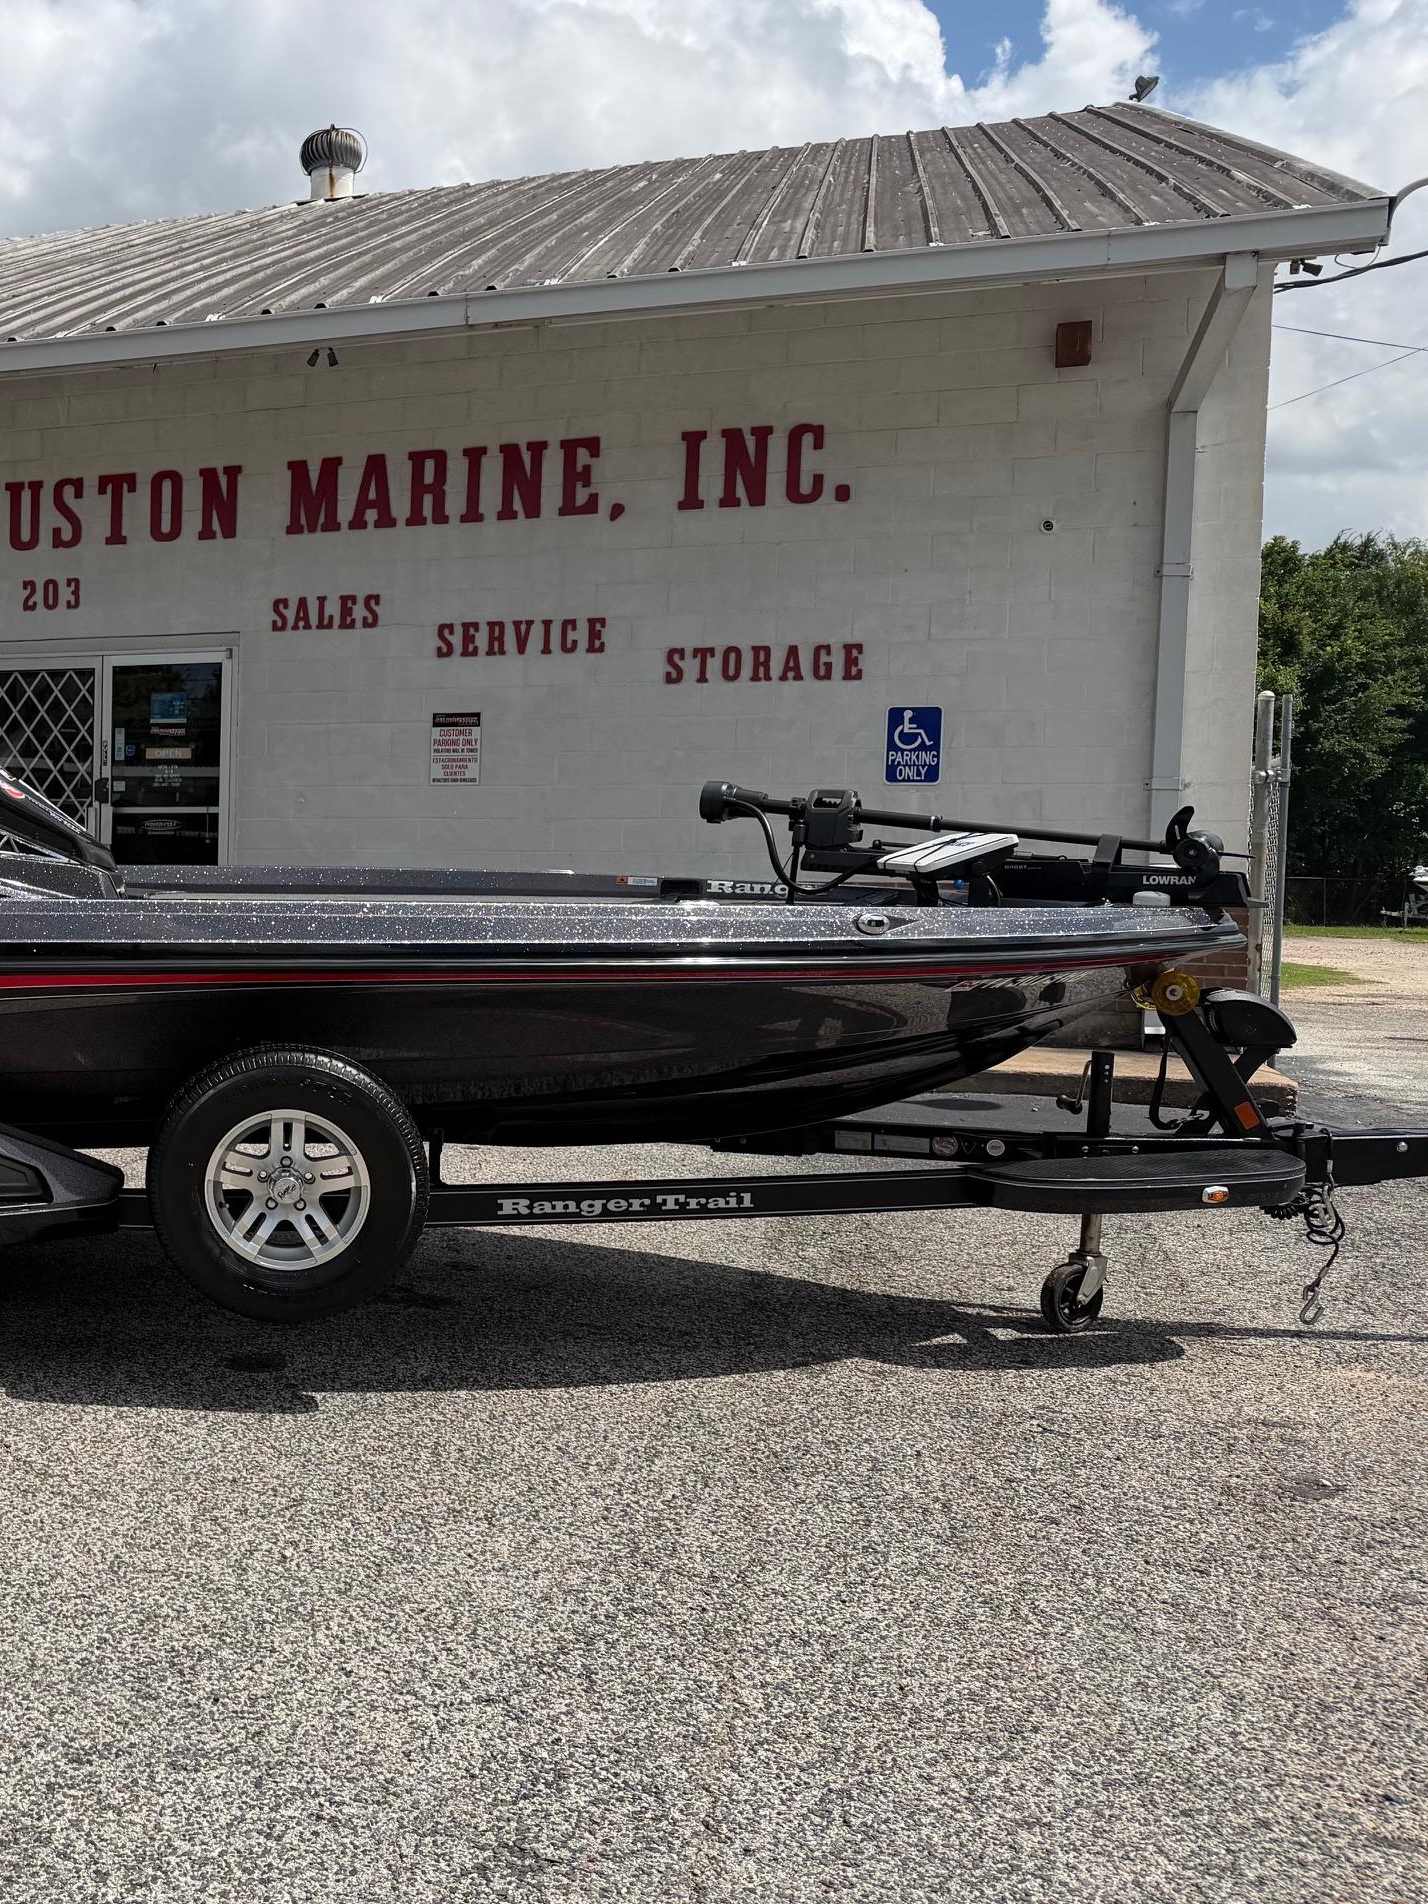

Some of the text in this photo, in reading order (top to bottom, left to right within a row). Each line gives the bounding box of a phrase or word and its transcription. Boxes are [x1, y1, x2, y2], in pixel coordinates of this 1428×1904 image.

[286, 436, 626, 535] MARINE,
[677, 423, 851, 511] INC.
[22, 577, 81, 611] 203
[272, 594, 381, 632] SALES
[436, 617, 607, 658] SERVICE
[665, 643, 864, 684] STORAGE
[433, 738, 478, 747] PARKING ONLY
[439, 728, 473, 738] CUSTOMER
[888, 751, 938, 765] PARKING
[896, 766, 928, 780] ONLY
[1142, 875, 1197, 885] LOWRAN
[497, 1192, 754, 1216] Ranger Trail
